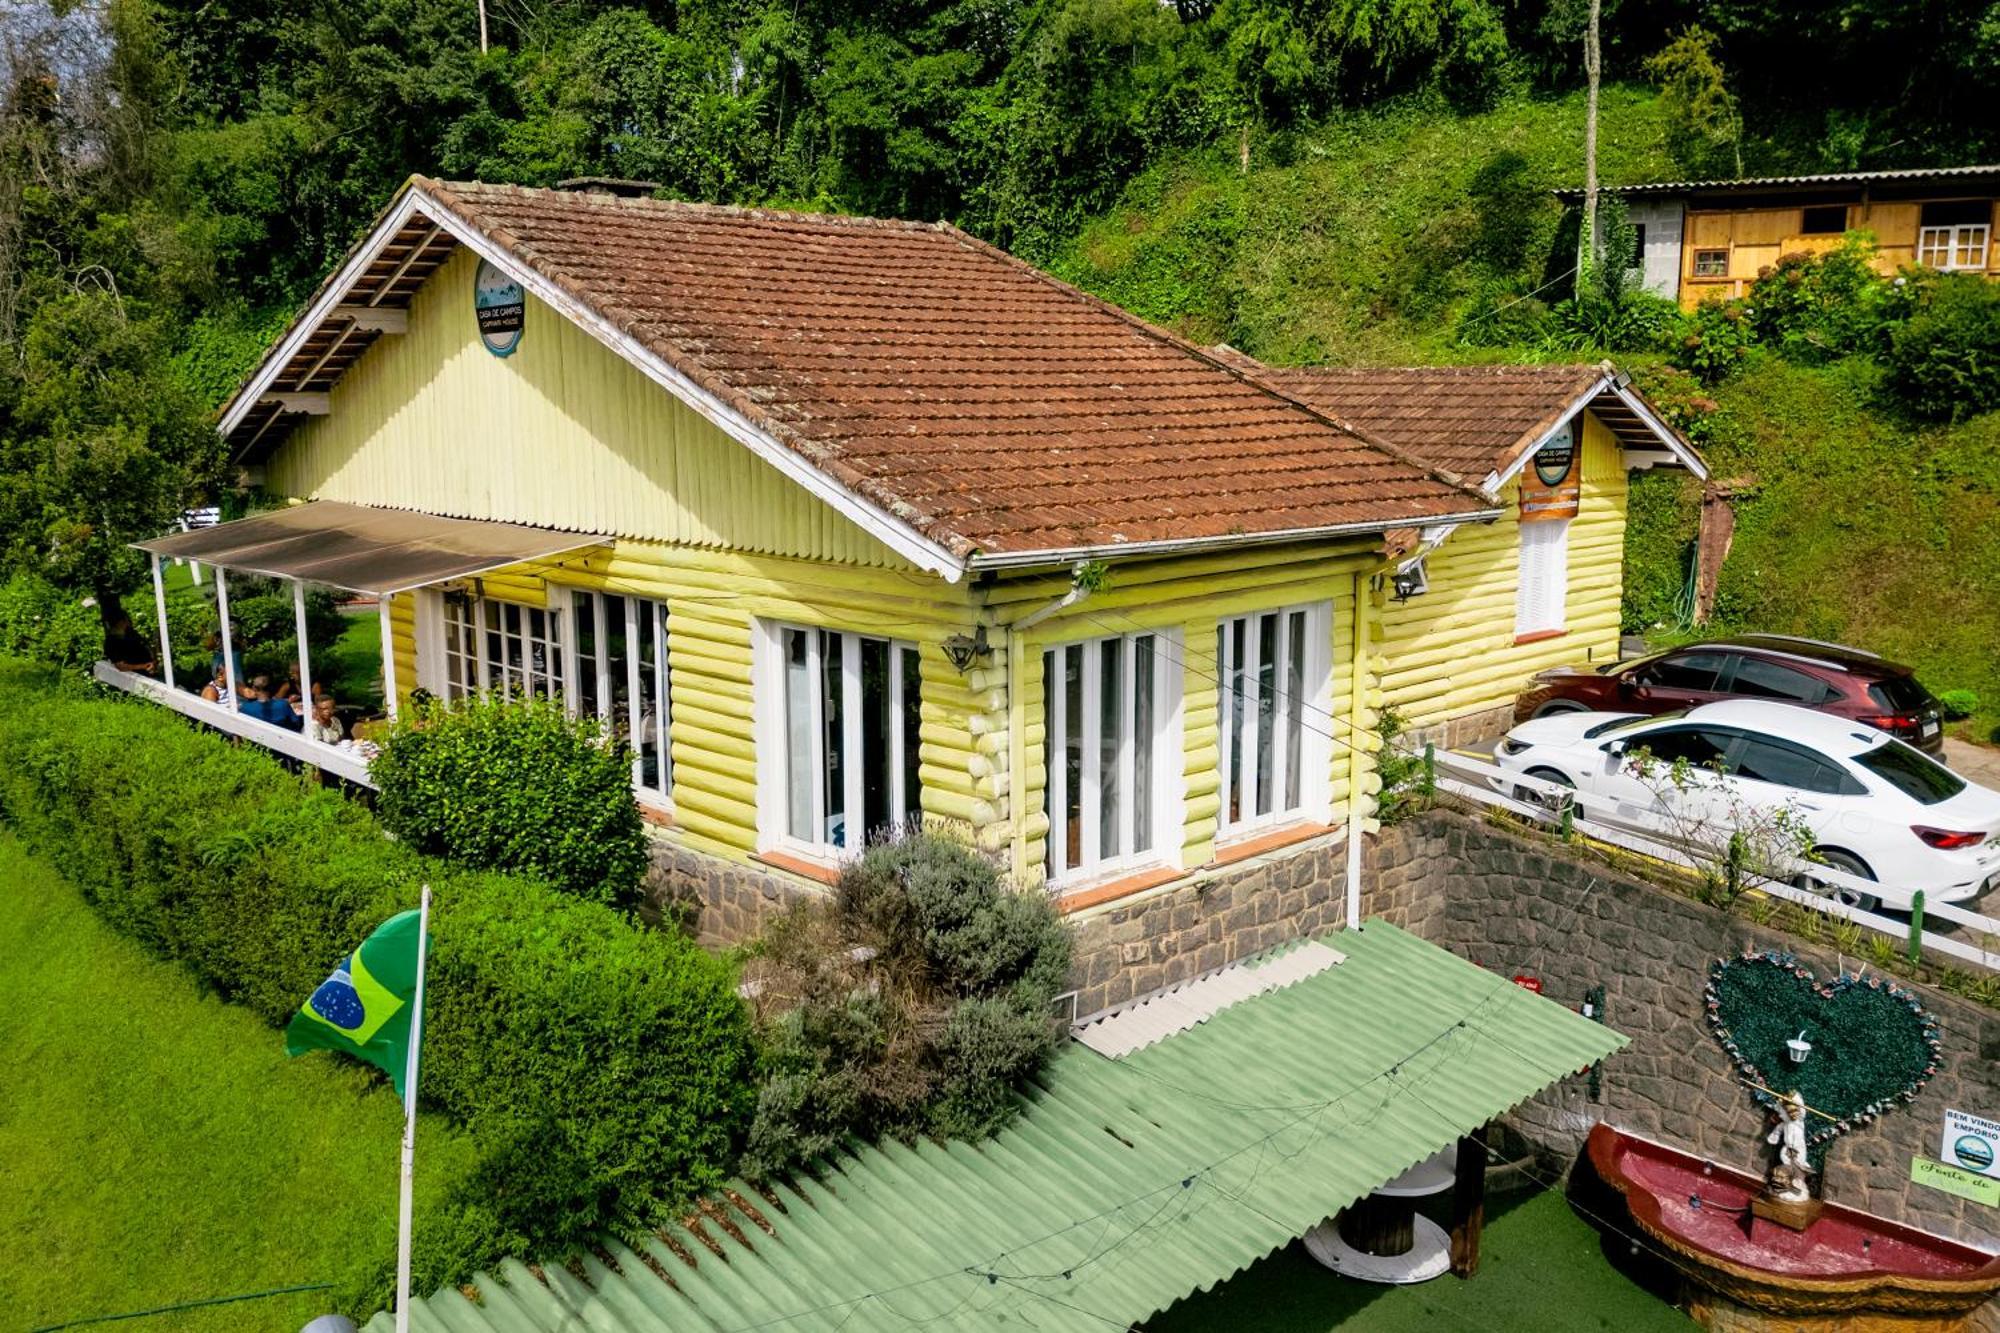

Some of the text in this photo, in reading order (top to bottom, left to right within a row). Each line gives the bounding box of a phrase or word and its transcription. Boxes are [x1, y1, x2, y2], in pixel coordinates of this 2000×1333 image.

[492, 309, 500, 317] DE
[500, 306, 522, 316] CAMPOS
[1947, 1111, 1968, 1121] BEM
